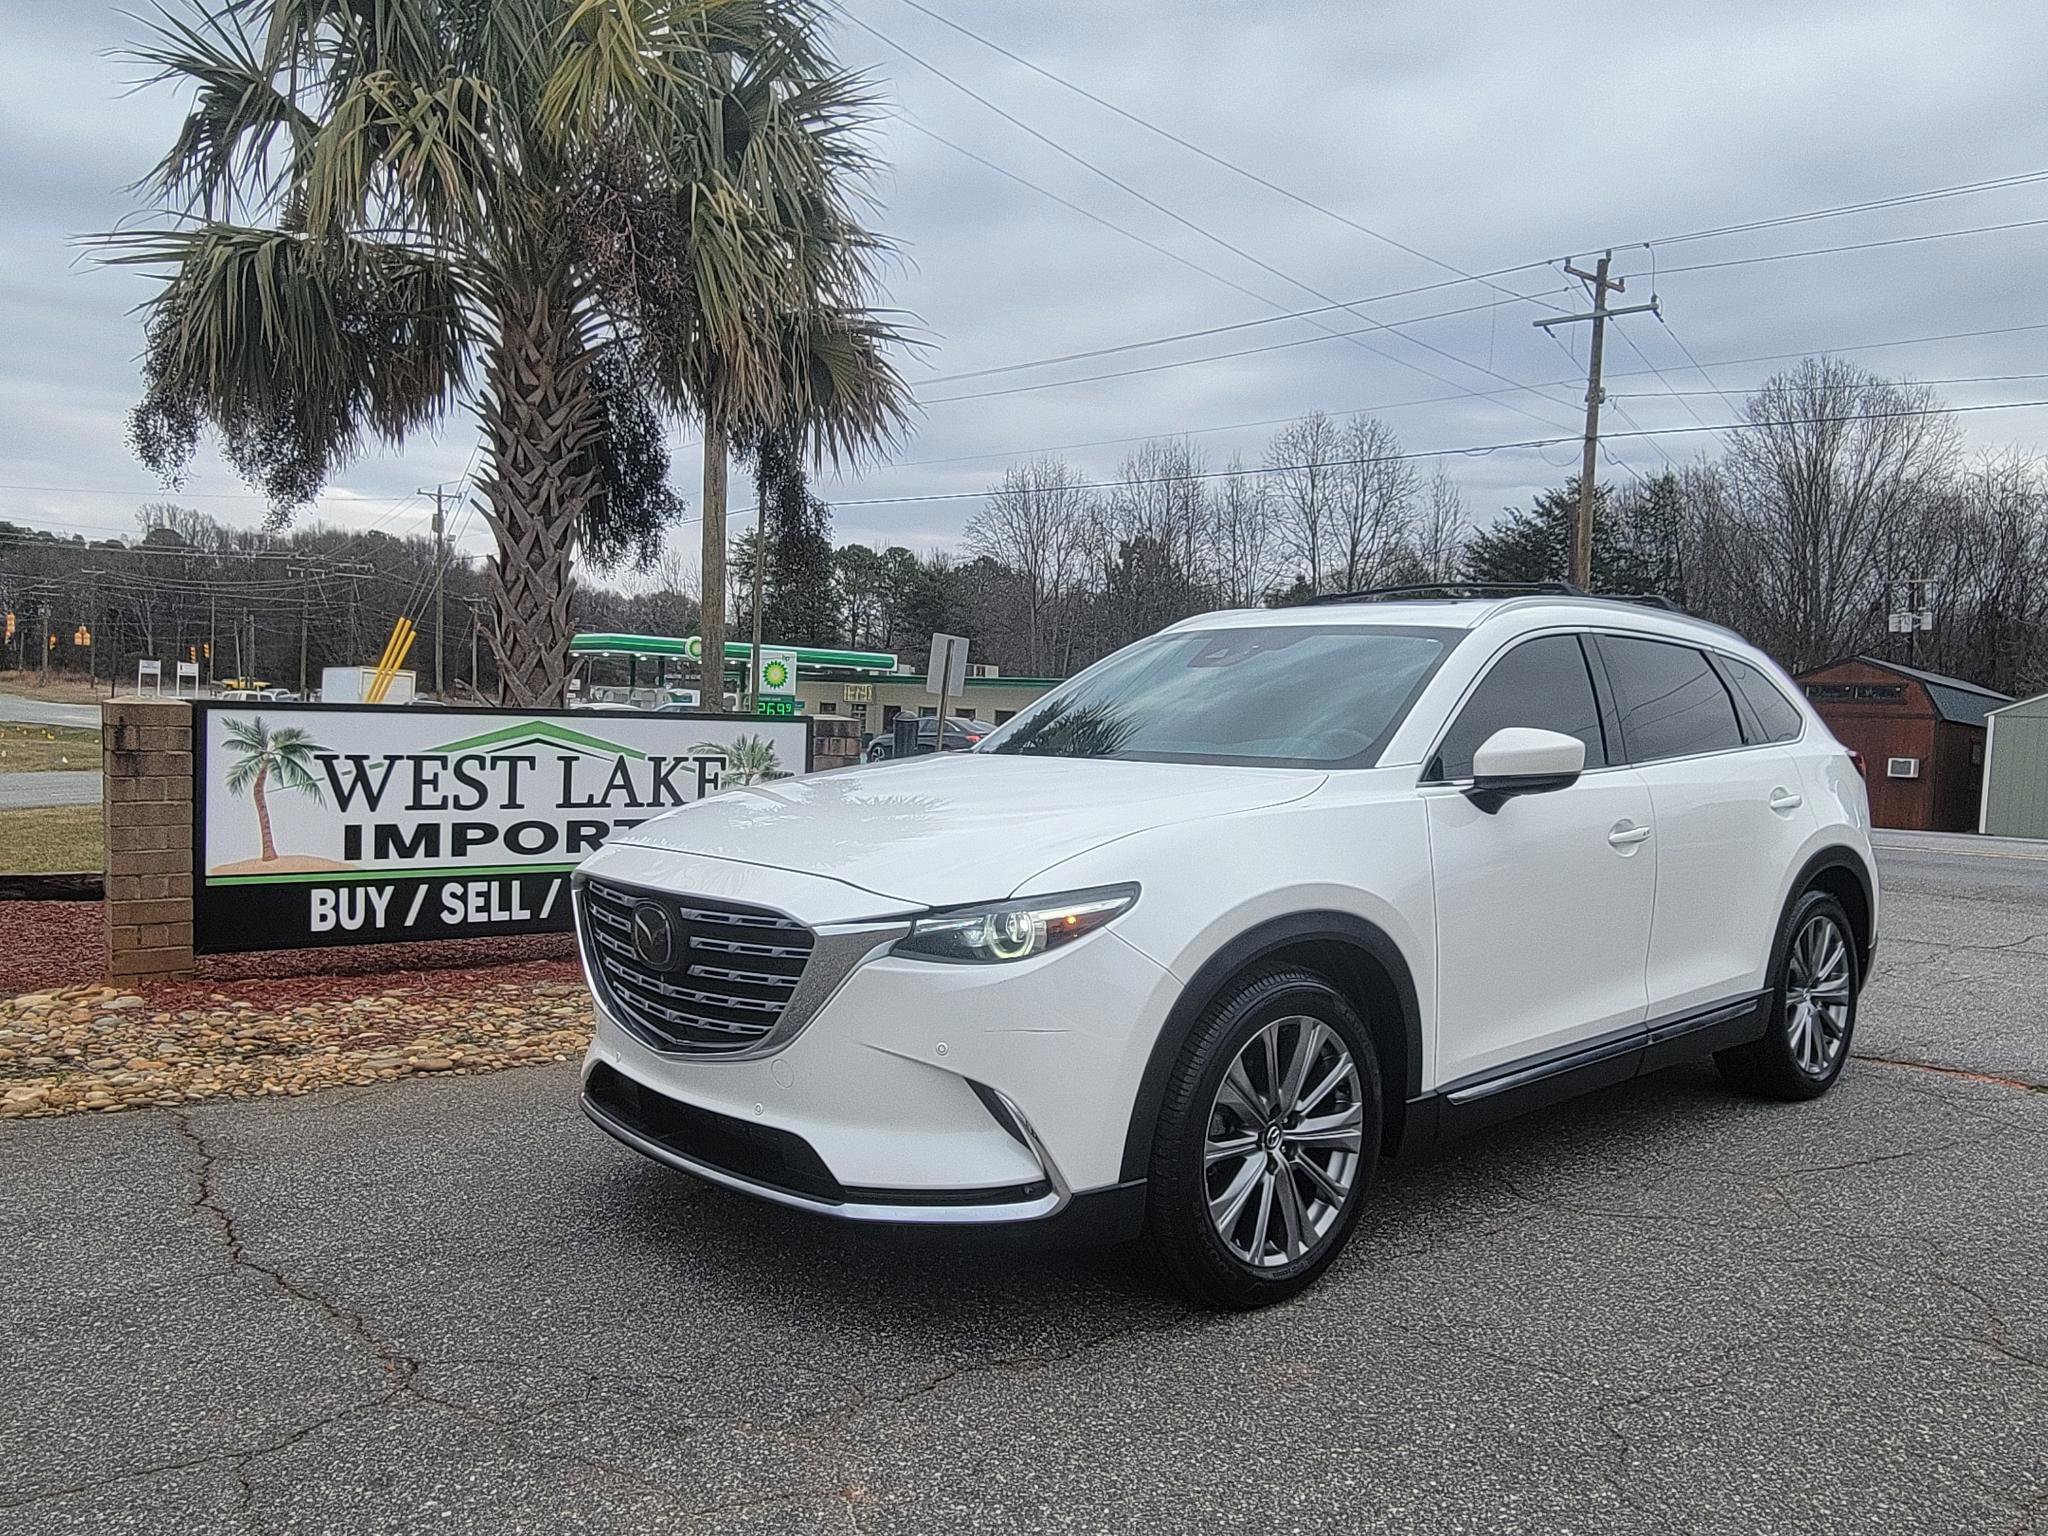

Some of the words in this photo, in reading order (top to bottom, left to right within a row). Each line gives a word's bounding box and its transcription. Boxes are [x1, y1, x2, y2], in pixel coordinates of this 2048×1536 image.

[313, 754, 536, 813] WEST
[556, 755, 727, 809] LAKE
[310, 885, 395, 932] BUY
[440, 880, 531, 925] SELL
